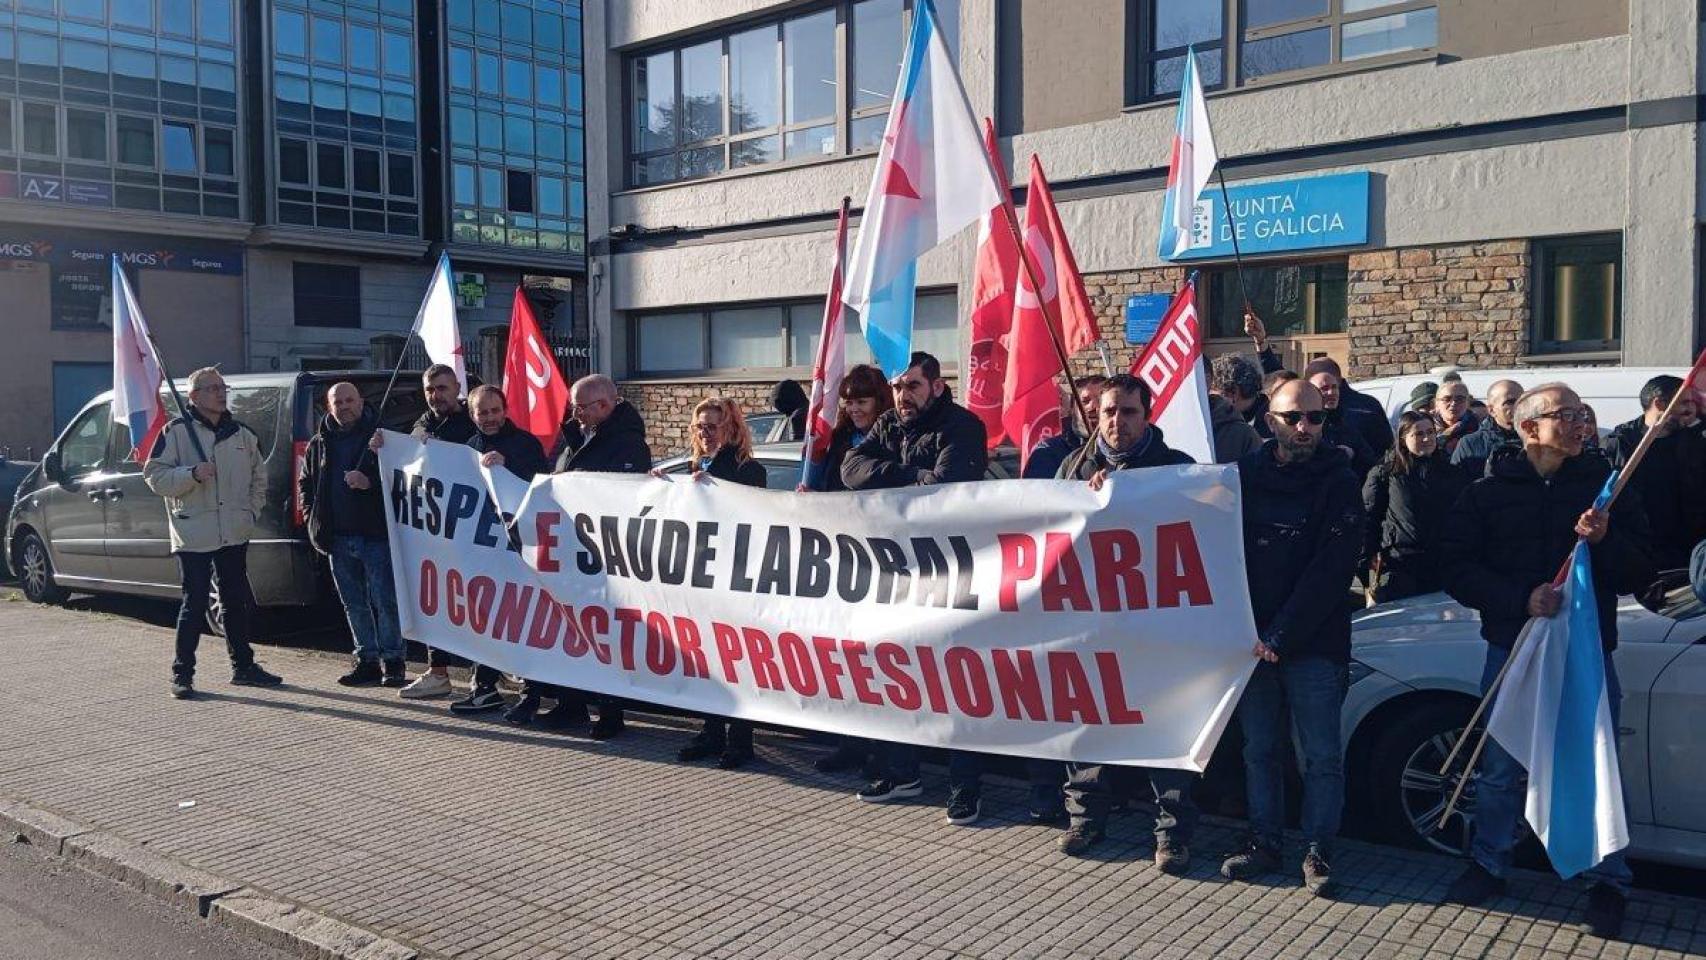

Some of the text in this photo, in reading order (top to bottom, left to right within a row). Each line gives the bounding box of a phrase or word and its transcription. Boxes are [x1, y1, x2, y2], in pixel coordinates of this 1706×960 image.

[23, 178, 61, 199] AZ
[1222, 195, 1296, 219] XUNTA
[1221, 213, 1344, 241] DE GALICIA
[71, 249, 105, 261] Seguros
[122, 252, 157, 265] MGS
[191, 258, 223, 269] Seguros
[535, 511, 561, 573] E
[574, 506, 719, 589] SAÚDE
[729, 523, 979, 610] LABORAL
[997, 520, 1214, 612] PARA
[420, 559, 1144, 725] O CONDUCTOR PROFESIONAL
